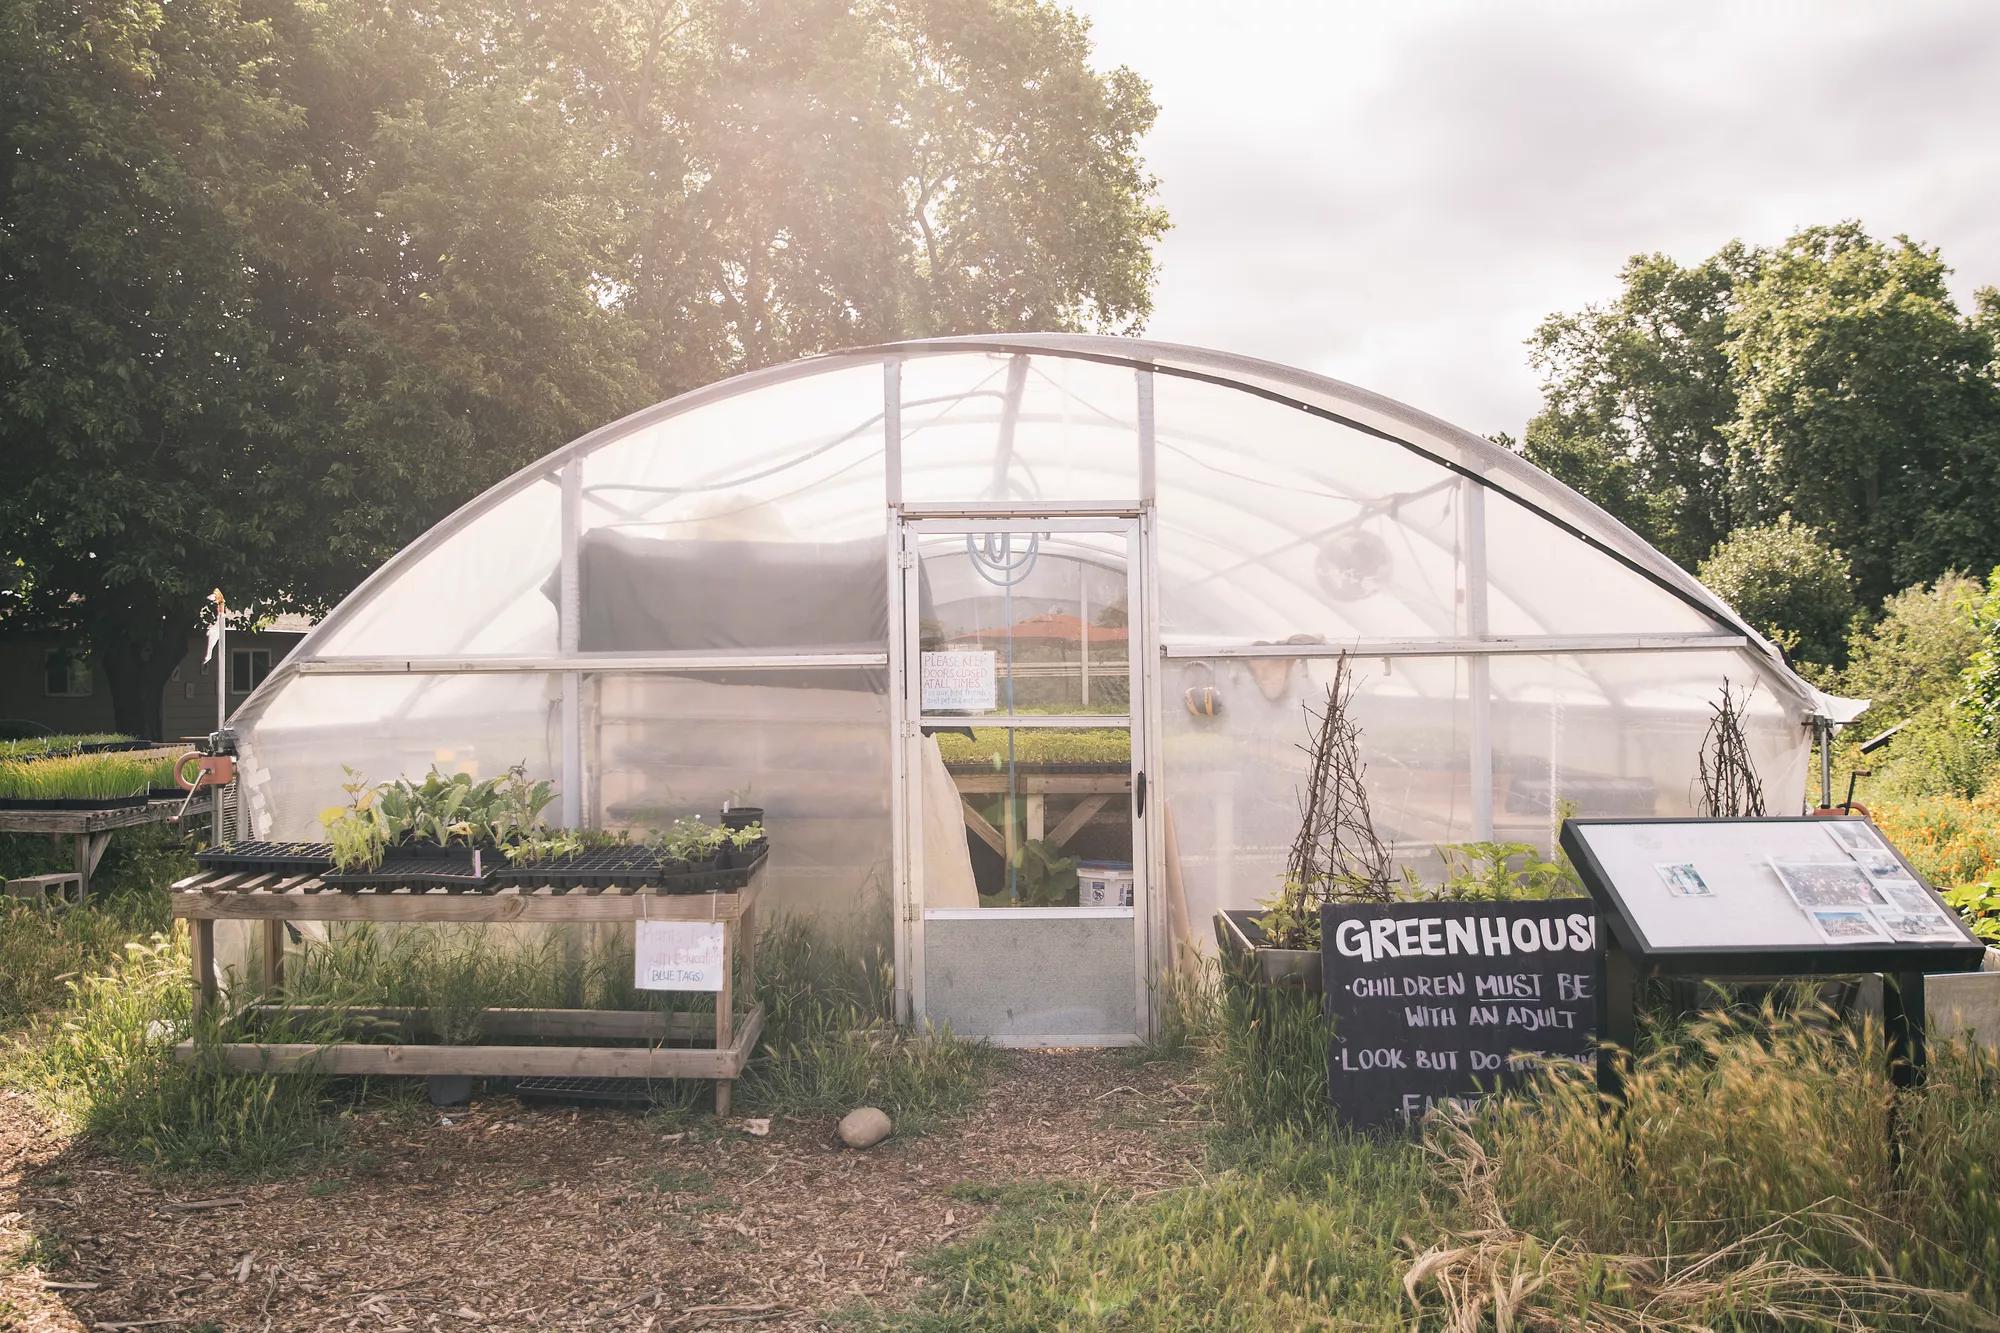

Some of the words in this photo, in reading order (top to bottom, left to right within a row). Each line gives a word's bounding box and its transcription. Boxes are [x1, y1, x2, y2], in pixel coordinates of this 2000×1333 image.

[923, 668, 954, 678] DOORS
[955, 667, 988, 678] CLOSED
[924, 655, 959, 667] PLEASE
[962, 655, 986, 667] KEEP
[1335, 913, 1596, 962] GREENHOUS
[677, 969, 705, 984] TAGS)
[1353, 972, 1466, 997] CHILDREN
[1477, 973, 1543, 1000] MUST
[1557, 973, 1593, 1001] BE
[1405, 1006, 1456, 1028] WITH
[1469, 1005, 1499, 1026] AN
[1506, 1008, 1577, 1031] ADULT
[1342, 1048, 1407, 1071] LOOK
[1416, 1050, 1459, 1071] BUT
